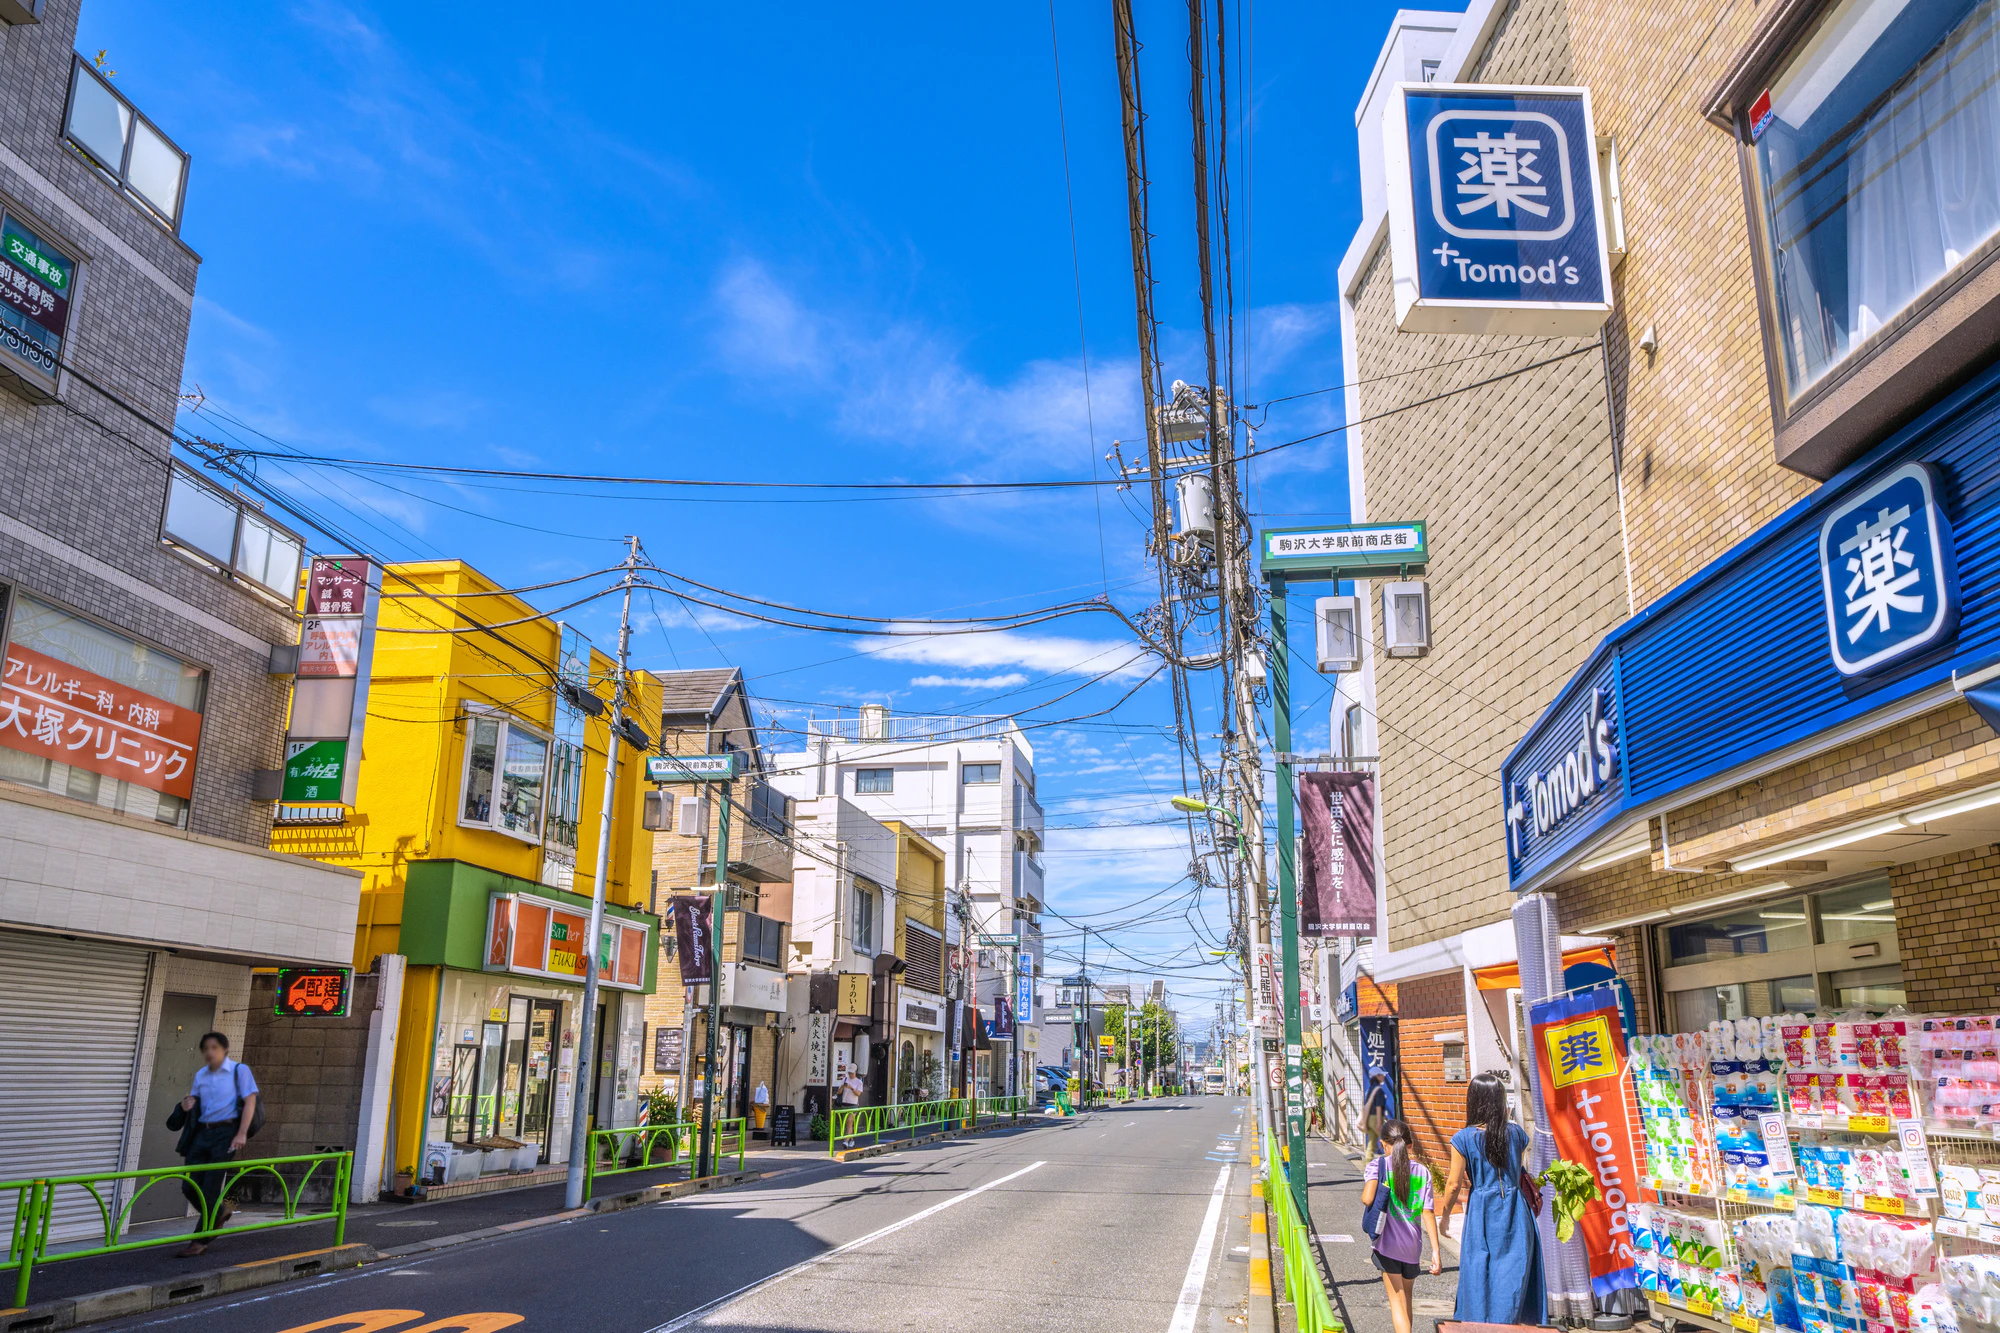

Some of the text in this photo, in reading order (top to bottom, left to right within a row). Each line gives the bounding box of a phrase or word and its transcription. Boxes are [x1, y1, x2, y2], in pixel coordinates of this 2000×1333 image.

[1453, 132, 1550, 218] 薬
[10, 238, 62, 286] 交通事故
[1453, 255, 1580, 285] Tomod's
[1279, 532, 1407, 551] 駒沢大学駅前商店街
[316, 562, 329, 571] 3F
[1839, 503, 1923, 645] 薬
[317, 576, 362, 585] マッサージ
[320, 602, 352, 613] 整骨院
[307, 621, 320, 630] 2F
[6, 657, 160, 731] アレルギー科・内科
[0, 696, 187, 780] 大塚クリニック
[292, 744, 305, 754] 1F
[1528, 687, 1617, 838] Tomod's
[305, 785, 318, 798] 酒
[551, 921, 581, 941] Barber
[1260, 965, 1272, 1004] 日能研
[810, 1016, 821, 1078] 炭火焼き鳥
[1871, 1118, 1886, 1126] 398
[1826, 1191, 1840, 1200] 398
[1886, 1199, 1902, 1208] 398
